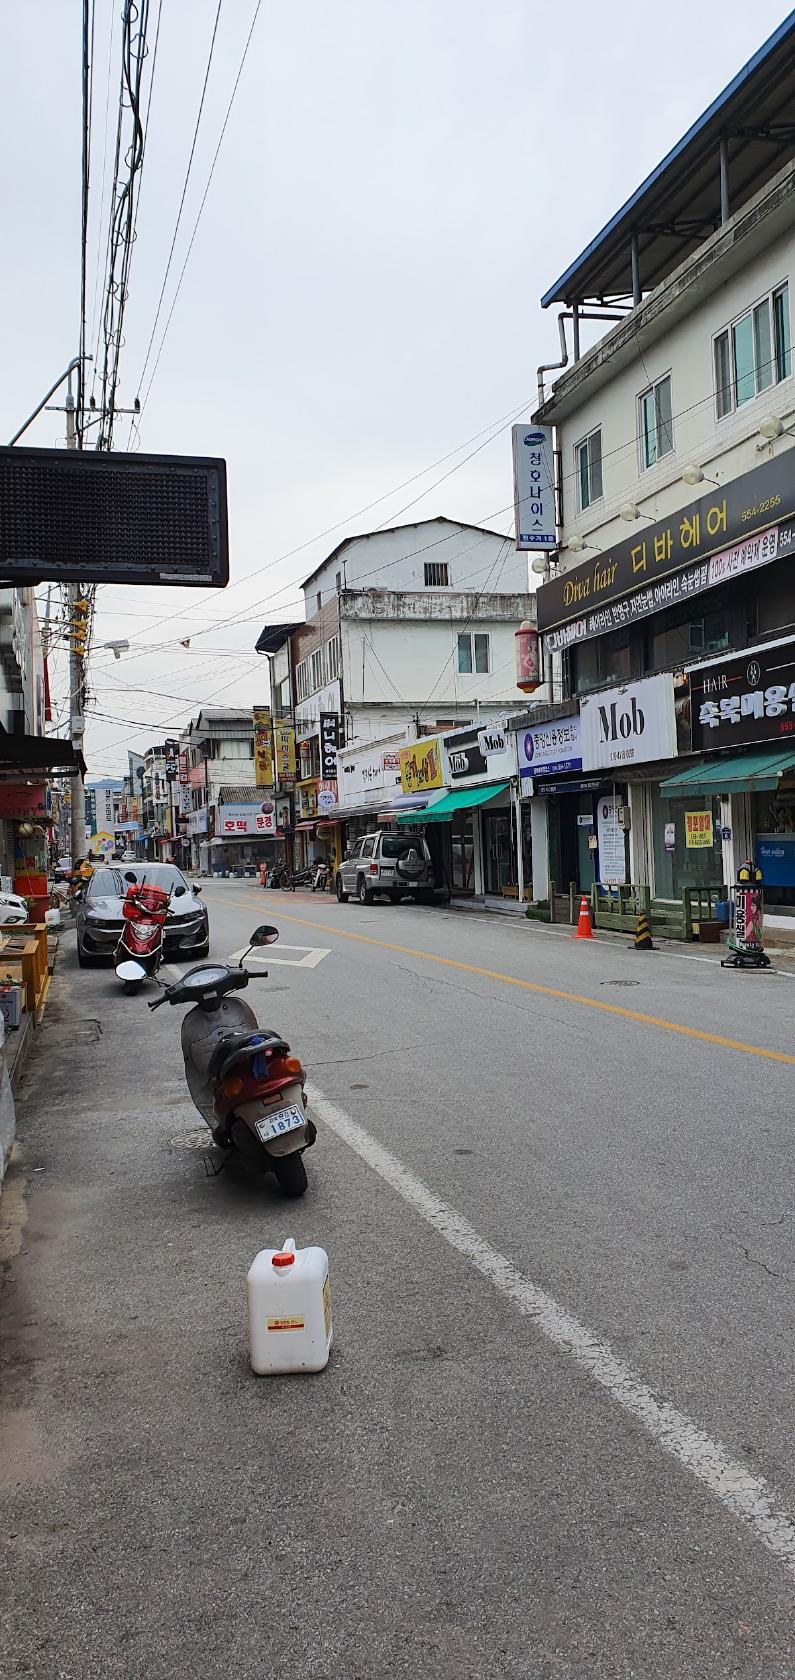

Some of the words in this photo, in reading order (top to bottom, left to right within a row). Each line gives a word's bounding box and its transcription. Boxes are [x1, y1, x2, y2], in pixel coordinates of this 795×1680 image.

[529, 451, 543, 532] 청호나이스
[629, 500, 728, 574] 디바헤어
[562, 576, 591, 607] Diva
[592, 558, 619, 592] hair
[703, 674, 728, 694] HAIR
[597, 697, 645, 744] Mob
[484, 734, 504, 751] Mob
[449, 753, 466, 774] Mob
[224, 820, 248, 832] 호떡
[256, 815, 272, 829] 문경
[271, 1116, 300, 1134] 1873
